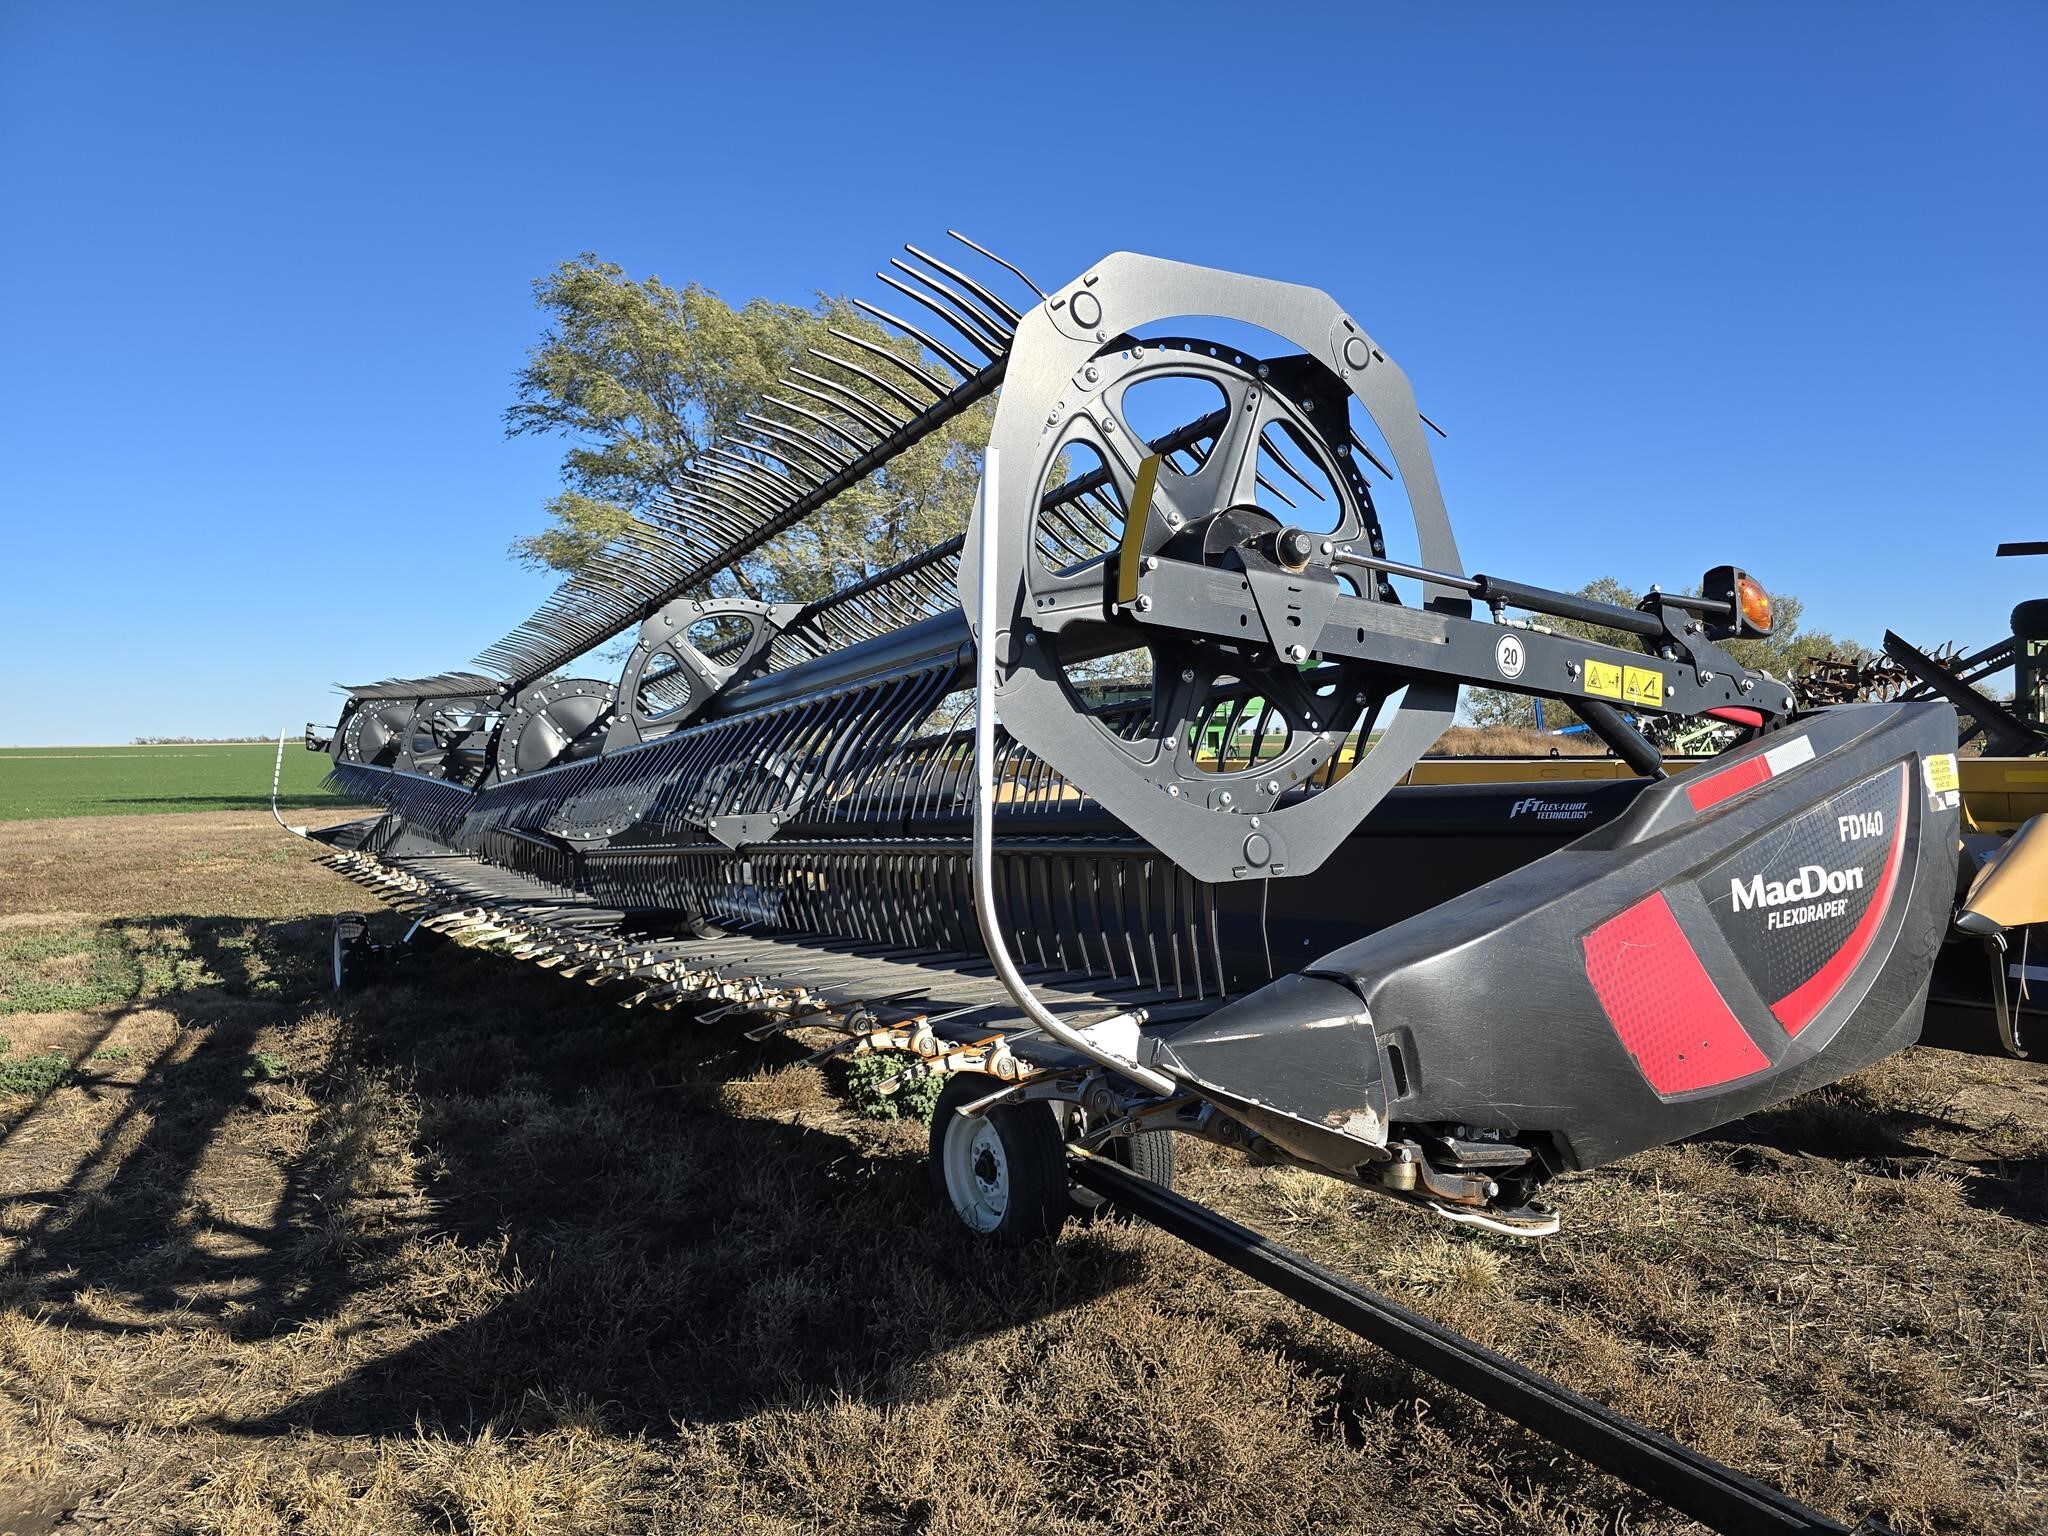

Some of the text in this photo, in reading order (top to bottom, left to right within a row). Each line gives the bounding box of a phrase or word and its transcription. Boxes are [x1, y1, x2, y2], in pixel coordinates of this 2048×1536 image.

[1504, 647, 1517, 665] 20
[1510, 798, 1543, 819] FFT
[1537, 811, 1588, 819] TECHNOLOGY
[1838, 811, 1883, 842] FD140
[1731, 865, 1863, 912] MacDon
[1768, 900, 1846, 930] FLEXDRAPER
